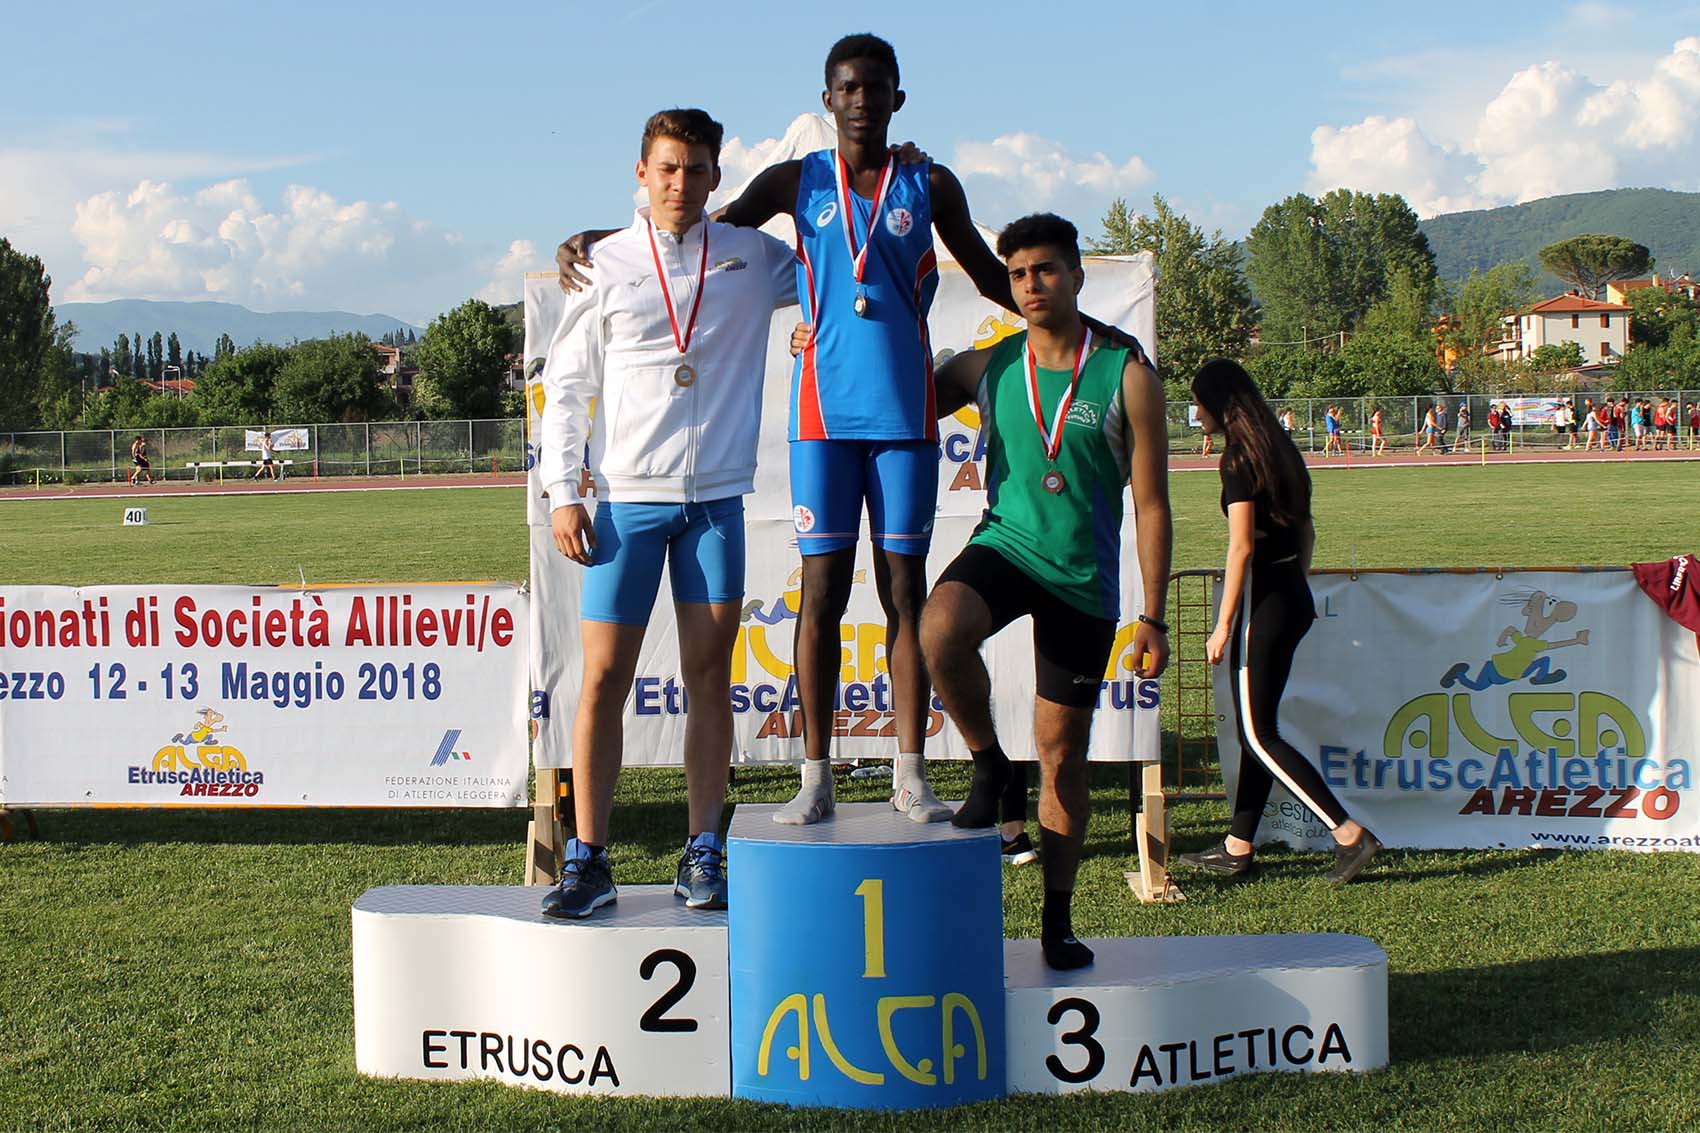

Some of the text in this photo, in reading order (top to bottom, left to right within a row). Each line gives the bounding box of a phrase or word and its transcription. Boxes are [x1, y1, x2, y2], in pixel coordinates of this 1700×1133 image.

[126, 510, 142, 523] 40
[125, 596, 160, 648] di
[174, 595, 331, 648] Società
[345, 594, 515, 653] Allievi/e
[88, 662, 127, 700] 12
[160, 662, 199, 701] 13
[221, 661, 349, 709] Maggio
[358, 662, 442, 701] 2018
[127, 765, 264, 785] EtruscAtletica
[180, 782, 259, 797] AREZZO
[385, 776, 511, 787] FEDERAZIONE ITALIANA
[1320, 744, 1690, 791] EtruscAtletica
[388, 790, 507, 801] DI ATLETICA LEGGERA
[1458, 784, 1680, 820] AREZZO
[854, 879, 887, 978] 1
[639, 948, 698, 1032] 2
[422, 1029, 620, 1088] ETRUSCA
[1045, 997, 1106, 1083] 3
[1129, 1023, 1352, 1088] ATLETICA
